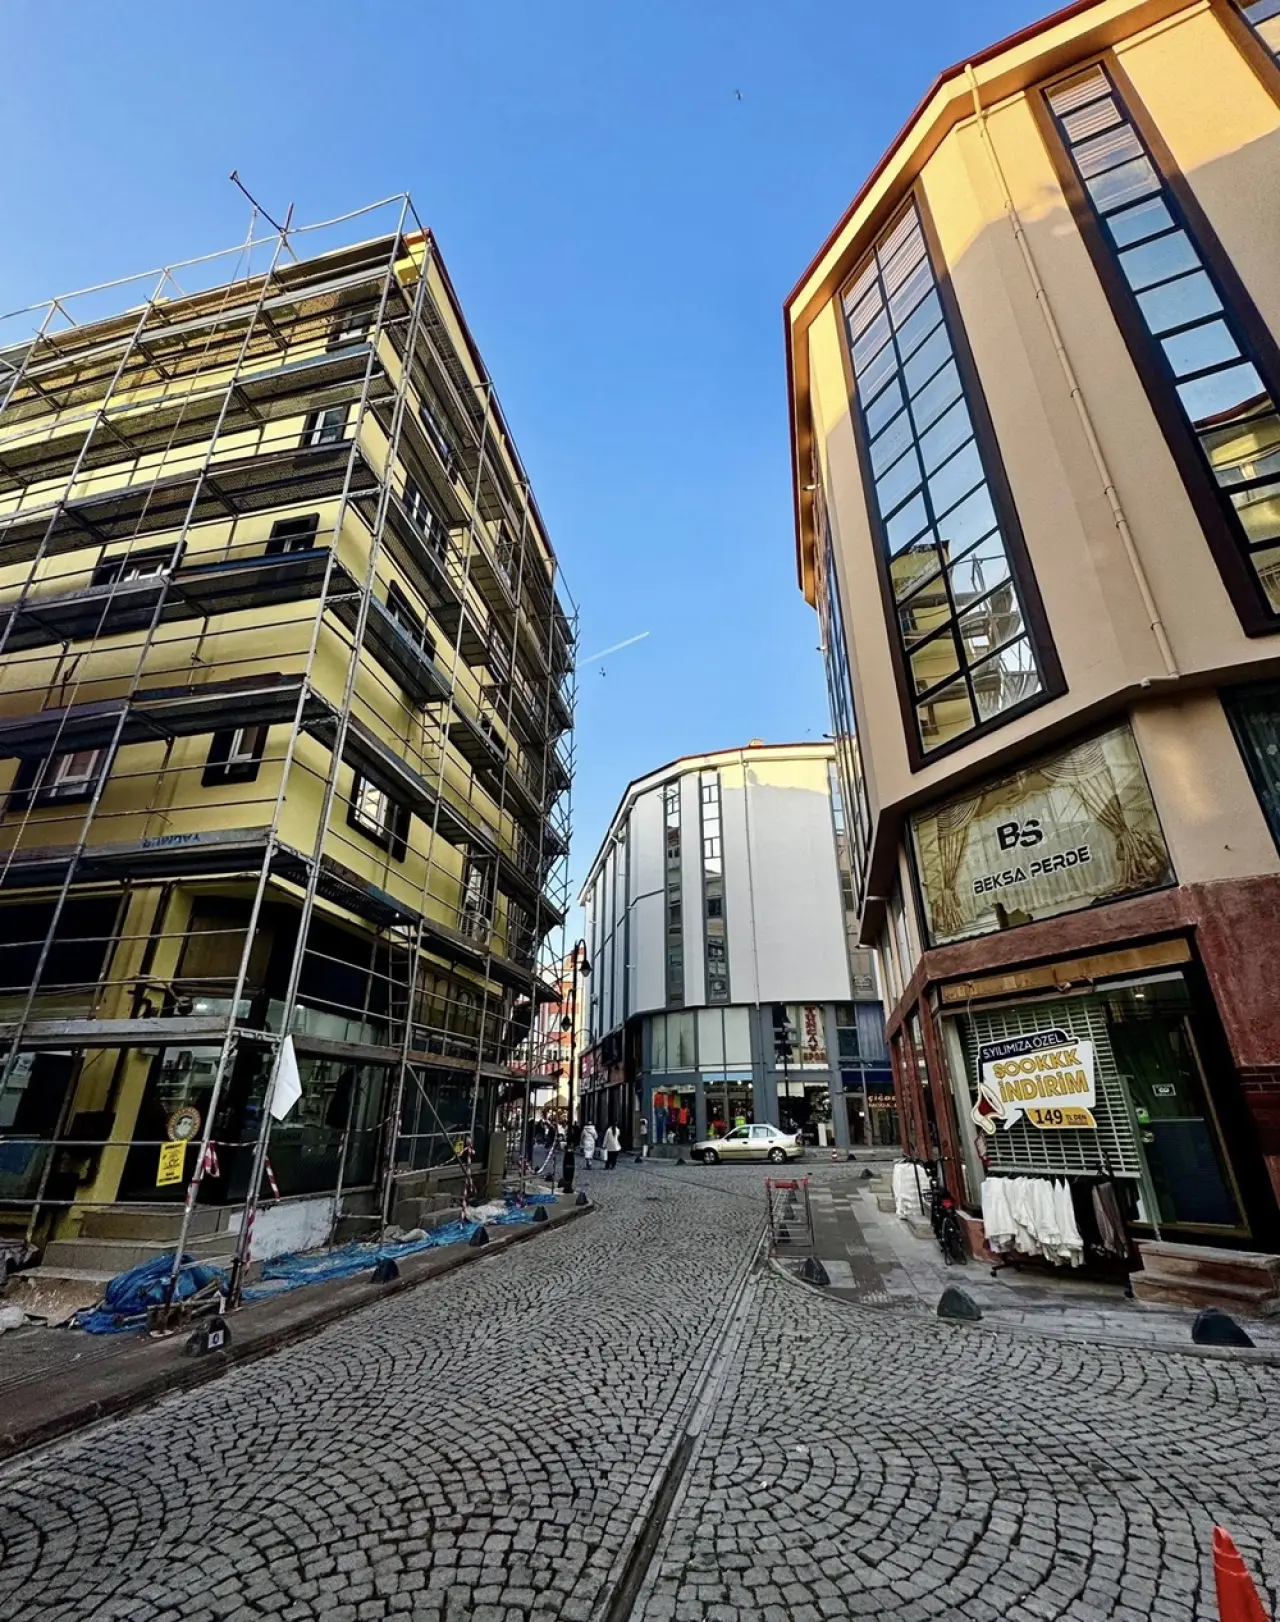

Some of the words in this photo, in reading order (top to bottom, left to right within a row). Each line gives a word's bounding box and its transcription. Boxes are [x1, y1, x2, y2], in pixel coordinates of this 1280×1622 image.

[996, 819, 1044, 851] BS
[973, 867, 1028, 895] BEKSA
[1029, 845, 1091, 878] PERDE
[1032, 1032, 1063, 1048] ÖZEL
[998, 1069, 1090, 1104] İNDİRİM
[1035, 1109, 1063, 1124] 149
